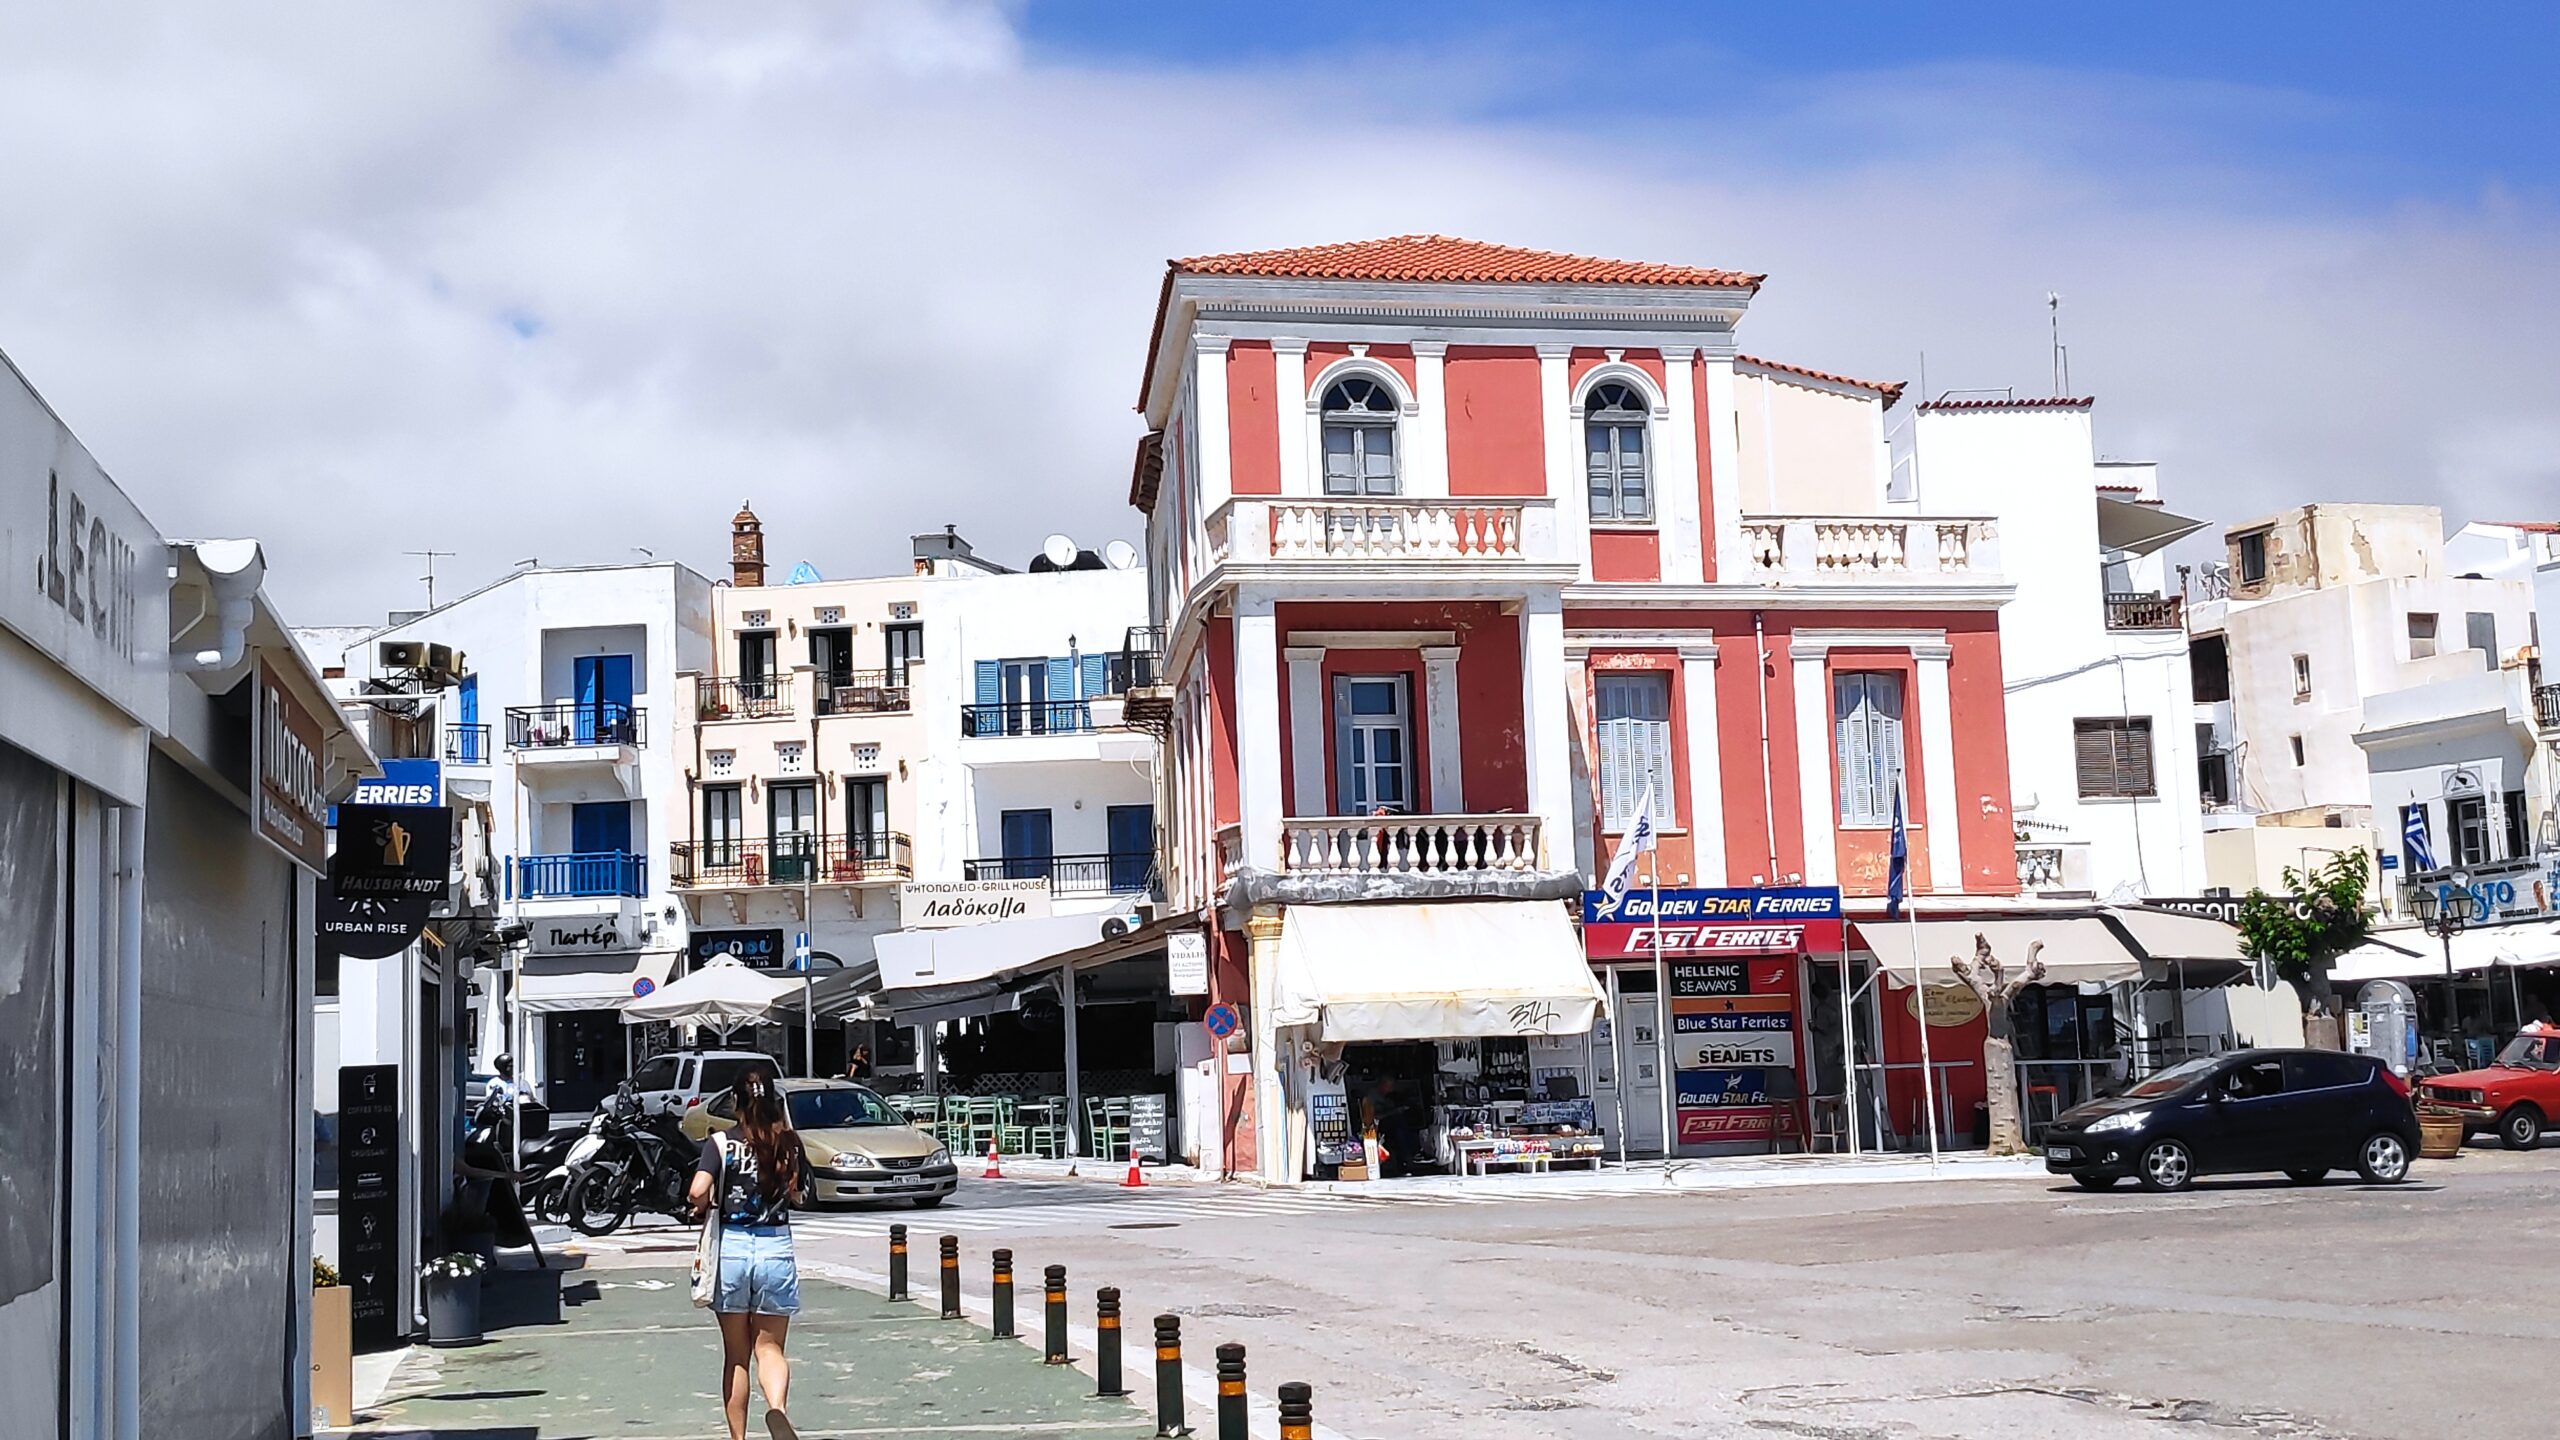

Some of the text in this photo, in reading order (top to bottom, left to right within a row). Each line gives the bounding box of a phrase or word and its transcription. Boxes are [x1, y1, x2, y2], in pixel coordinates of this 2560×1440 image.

[354, 785, 433, 804] ERRIES
[341, 876, 442, 892] HAUSBRANDT
[1012, 880, 1047, 890] HOUSE
[1624, 896, 1833, 916] GOLDEN STAR FERRIES
[325, 922, 408, 934] URBAN RISE
[1674, 965, 1740, 978] HELLENIC
[1680, 980, 1737, 993] SEAWAYS
[1677, 1015, 1787, 1030] Blue Star Ferries
[1698, 1049, 1775, 1063] SEAJETS
[1678, 1092, 1720, 1104] GOLDEN
[1721, 1092, 1749, 1103] STAR
[1726, 1114, 1792, 1130] FERRS
